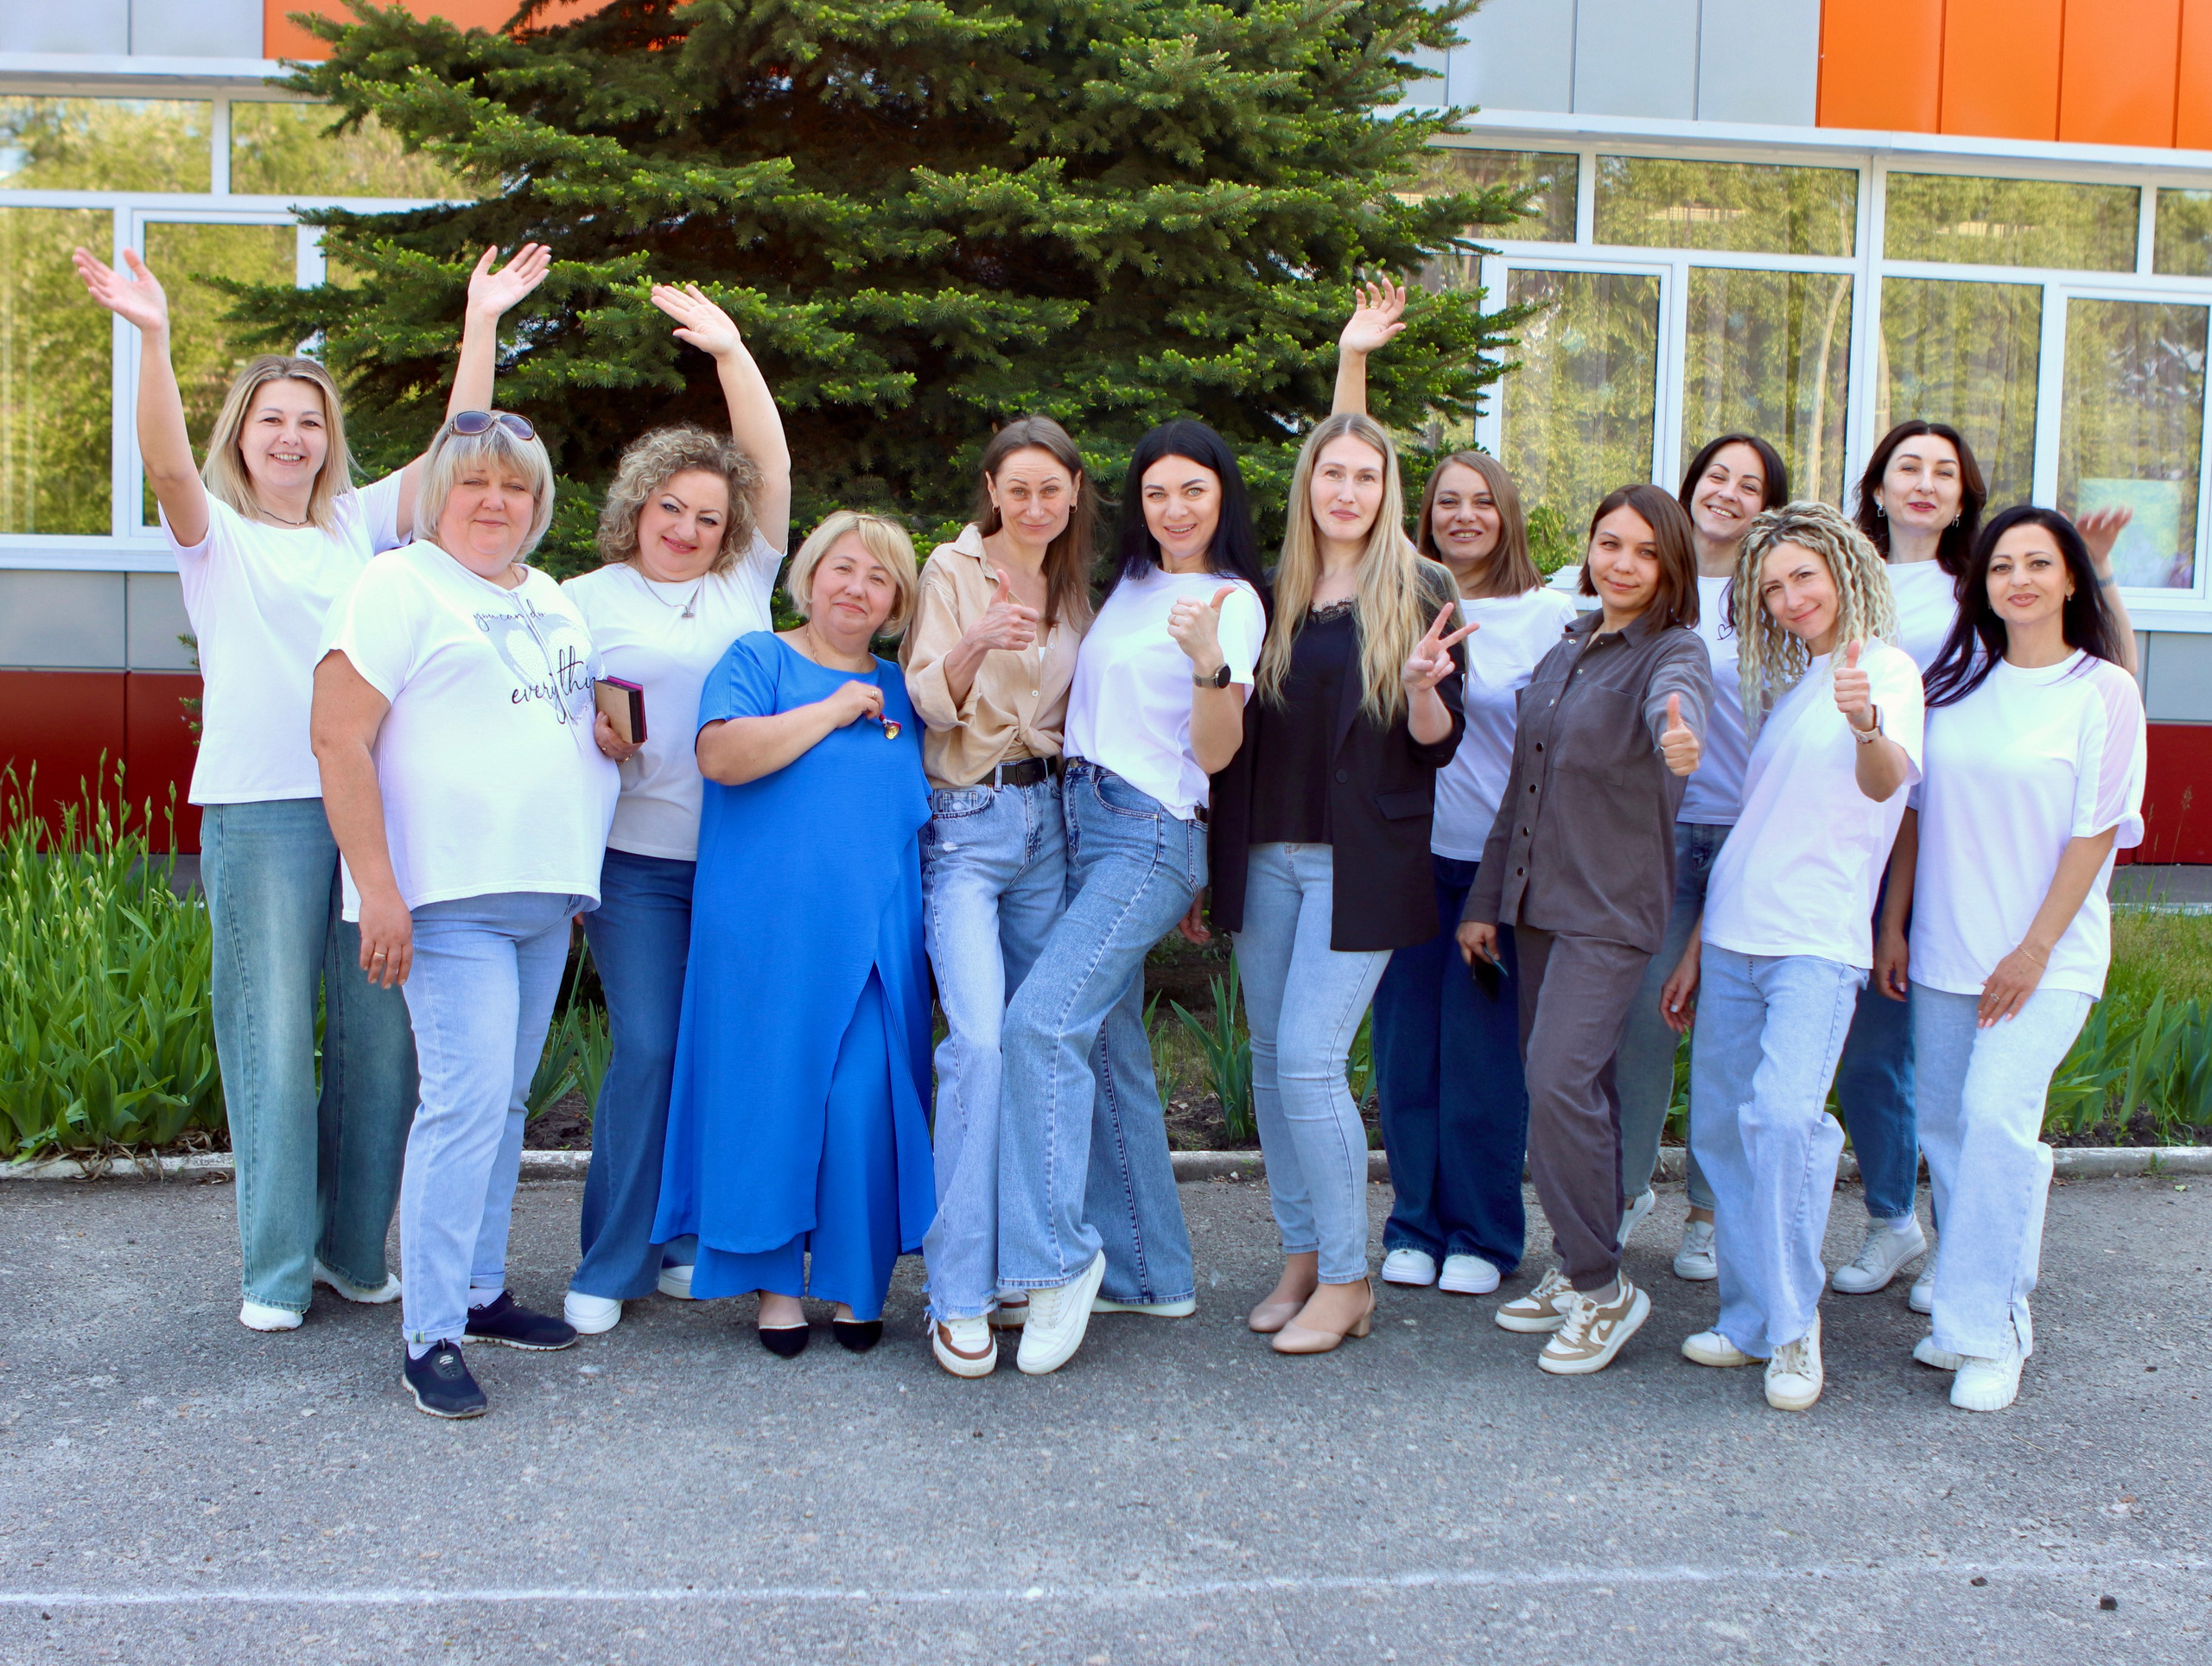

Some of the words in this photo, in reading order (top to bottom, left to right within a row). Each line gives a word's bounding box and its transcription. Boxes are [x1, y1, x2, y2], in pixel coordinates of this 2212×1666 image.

[474, 613, 499, 632] you
[499, 613, 524, 621] can
[526, 599, 546, 620] do
